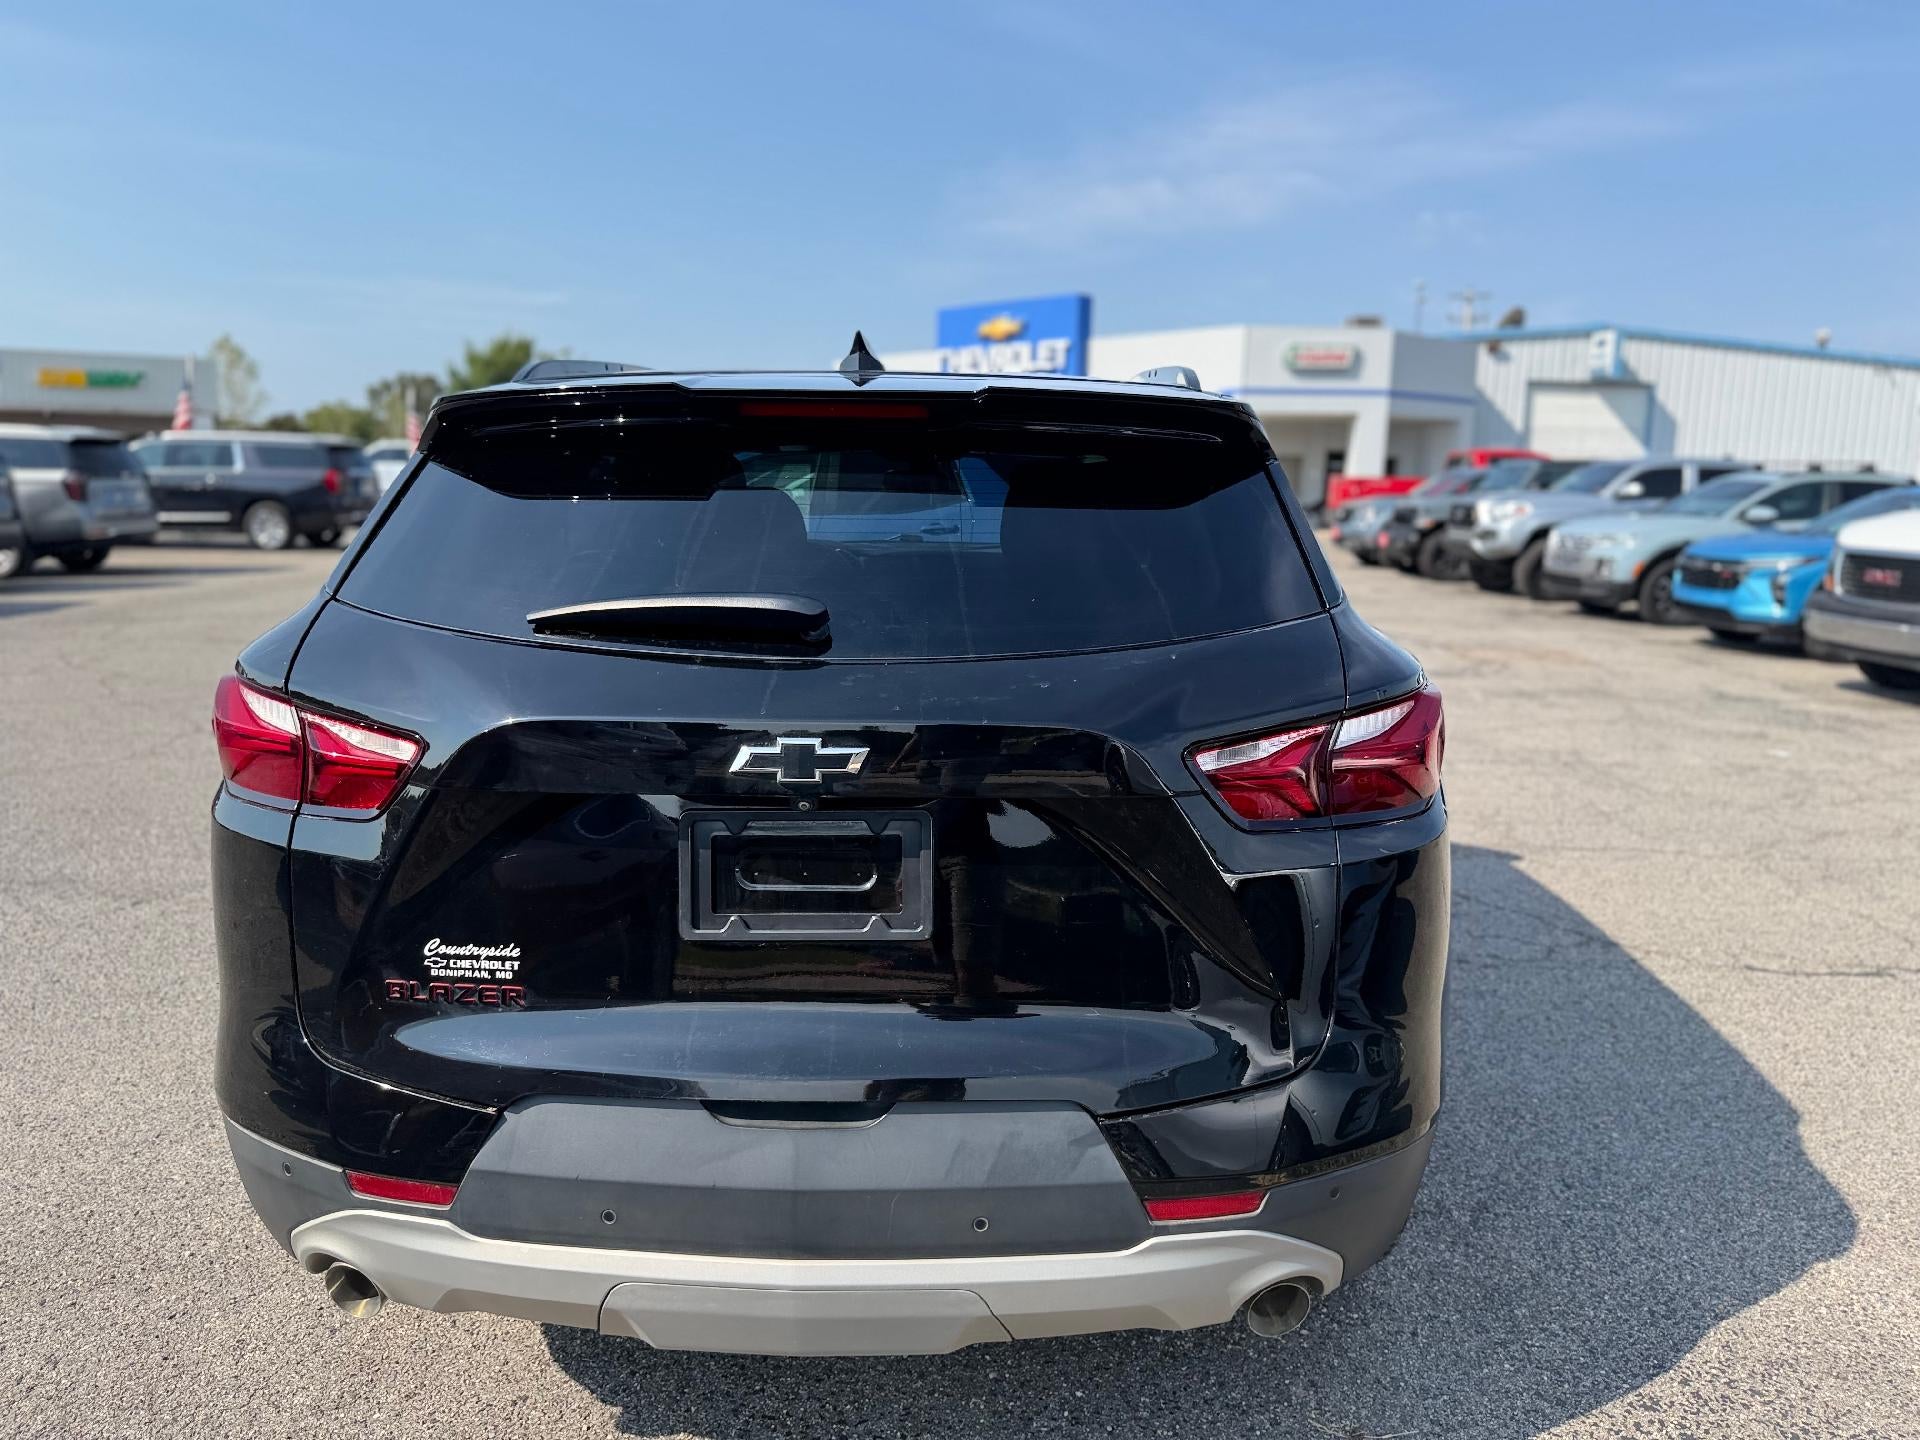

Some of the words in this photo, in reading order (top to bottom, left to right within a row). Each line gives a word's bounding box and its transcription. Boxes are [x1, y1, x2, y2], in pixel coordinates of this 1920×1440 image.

[423, 937, 521, 959] Countryside
[430, 967, 492, 980] DONIPHAN,
[495, 970, 513, 980] MO
[449, 959, 521, 971] CHEVROLET
[384, 979, 526, 1008] BLAZER
